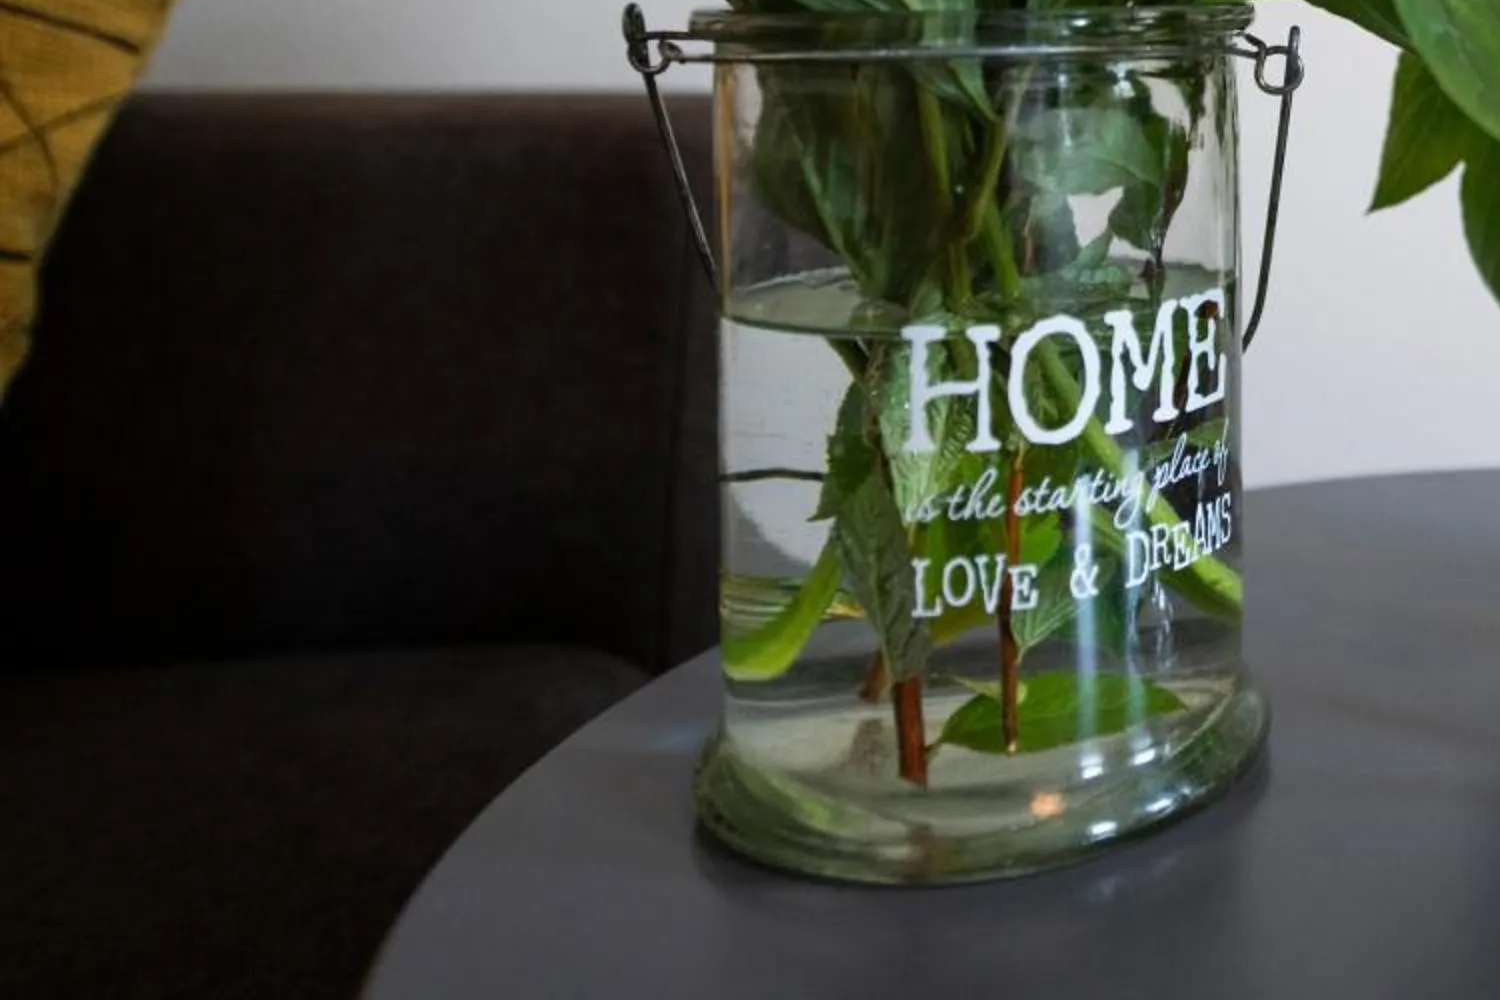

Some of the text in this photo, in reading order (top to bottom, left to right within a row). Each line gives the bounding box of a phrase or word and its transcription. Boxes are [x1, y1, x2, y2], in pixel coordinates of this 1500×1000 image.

[902, 288, 1226, 453] HOME
[904, 489, 941, 523] is
[945, 467, 1007, 520] the
[1013, 464, 1146, 529] starting
[1144, 432, 1211, 512] place
[911, 492, 1232, 619] LOVE & DREAMS
